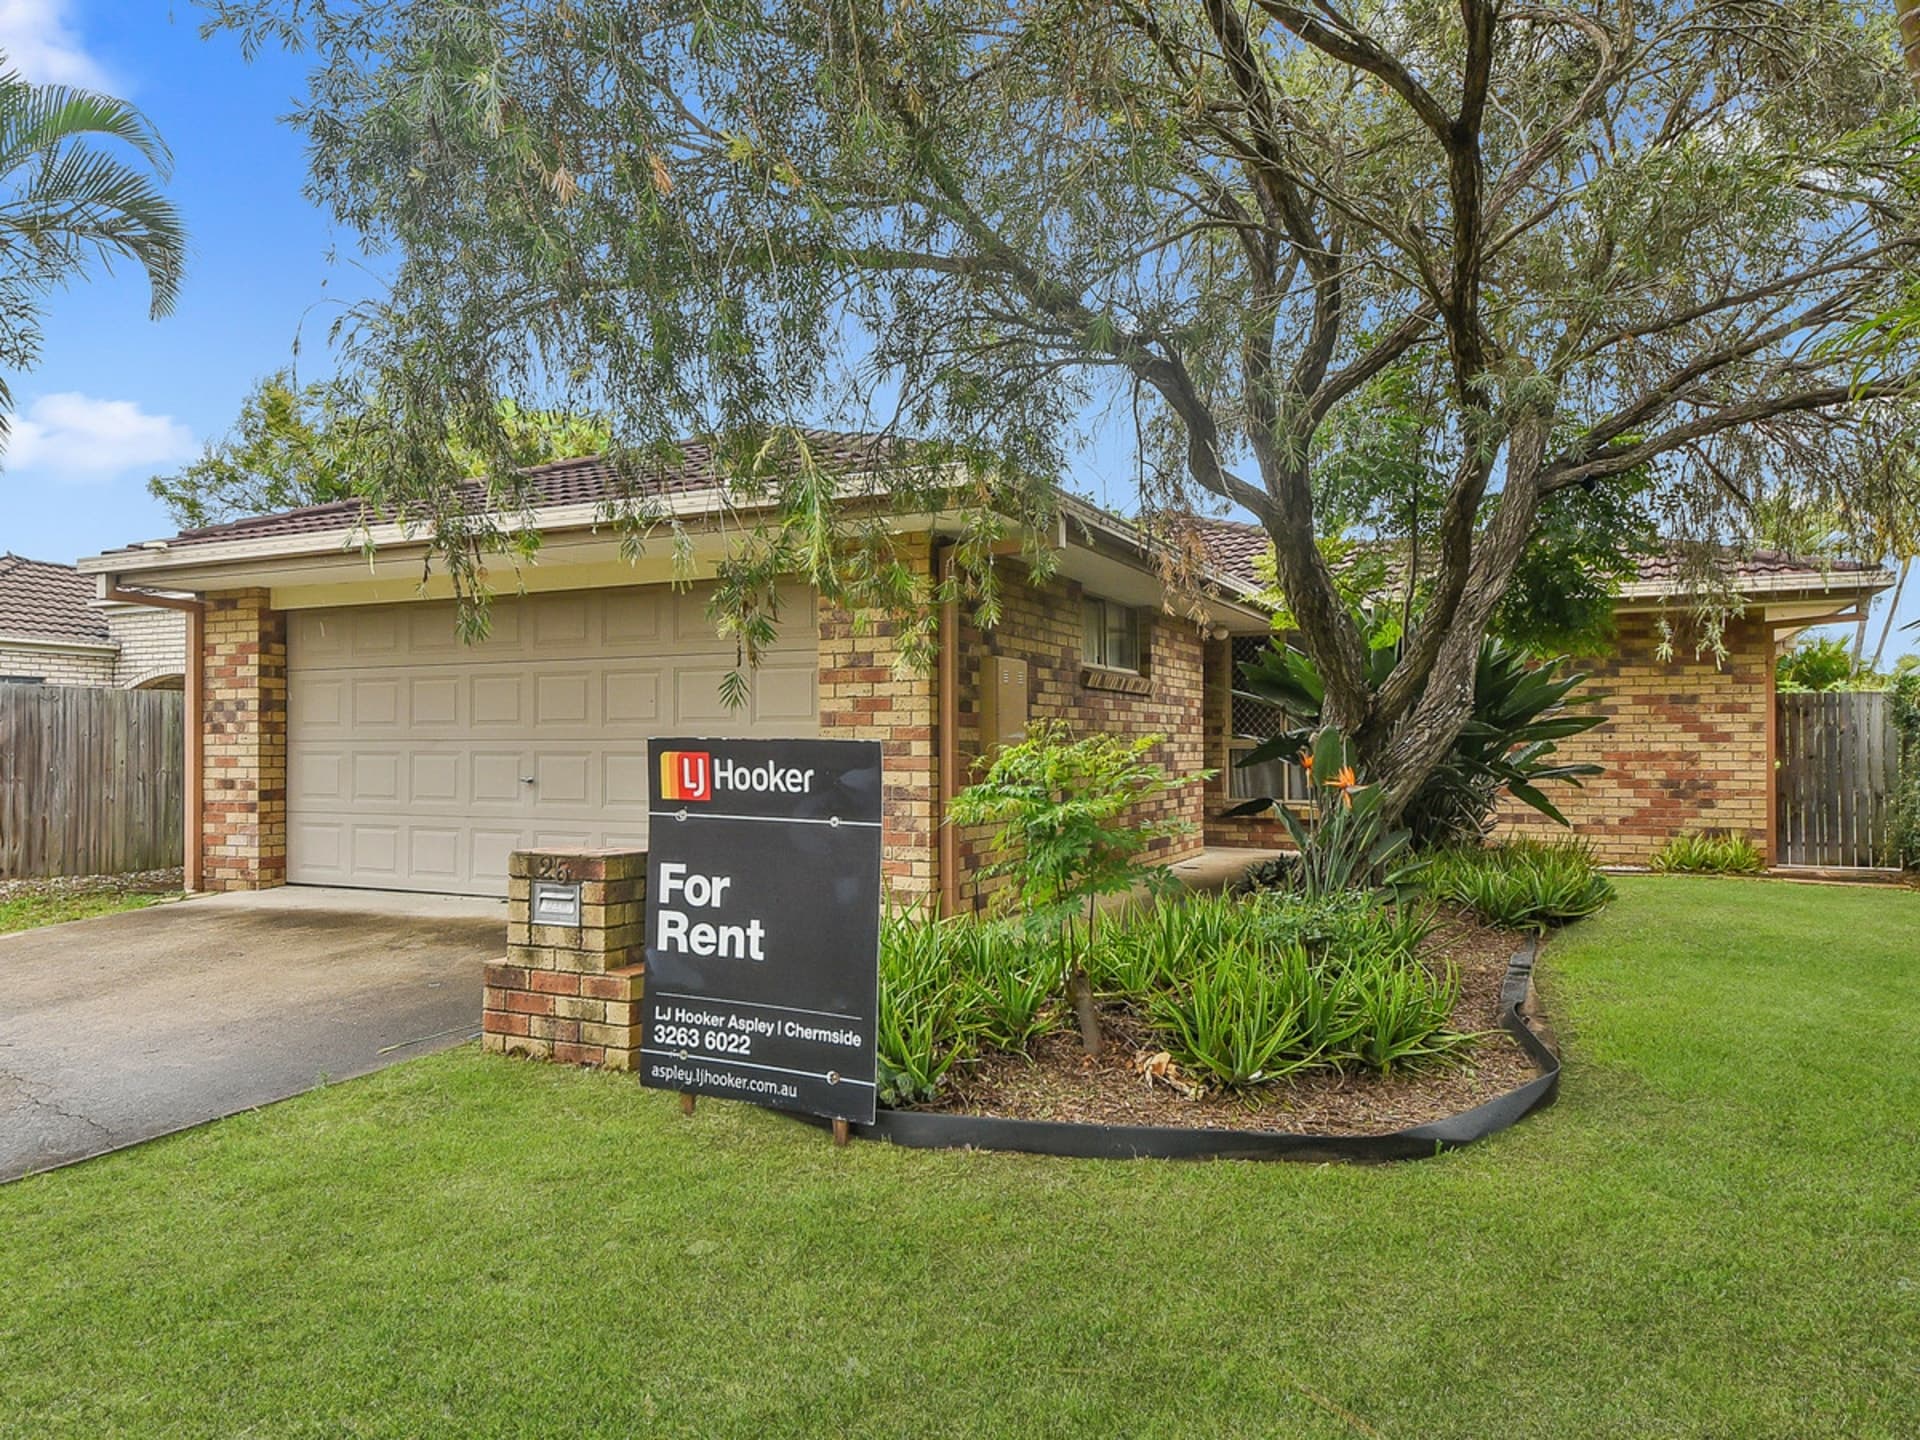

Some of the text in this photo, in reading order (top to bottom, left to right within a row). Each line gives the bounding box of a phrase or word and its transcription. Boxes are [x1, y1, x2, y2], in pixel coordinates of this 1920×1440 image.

[713, 758, 815, 793] Hooker
[658, 862, 731, 908] For
[656, 909, 765, 961] Rent
[653, 1023, 751, 1056] 3263 6022
[654, 1005, 672, 1022] LJ
[674, 1007, 725, 1028] Hooker
[727, 1014, 775, 1038] Aspley
[783, 1021, 863, 1048] Chermside
[651, 1063, 798, 1098] aspley.ljhooker.com.au
